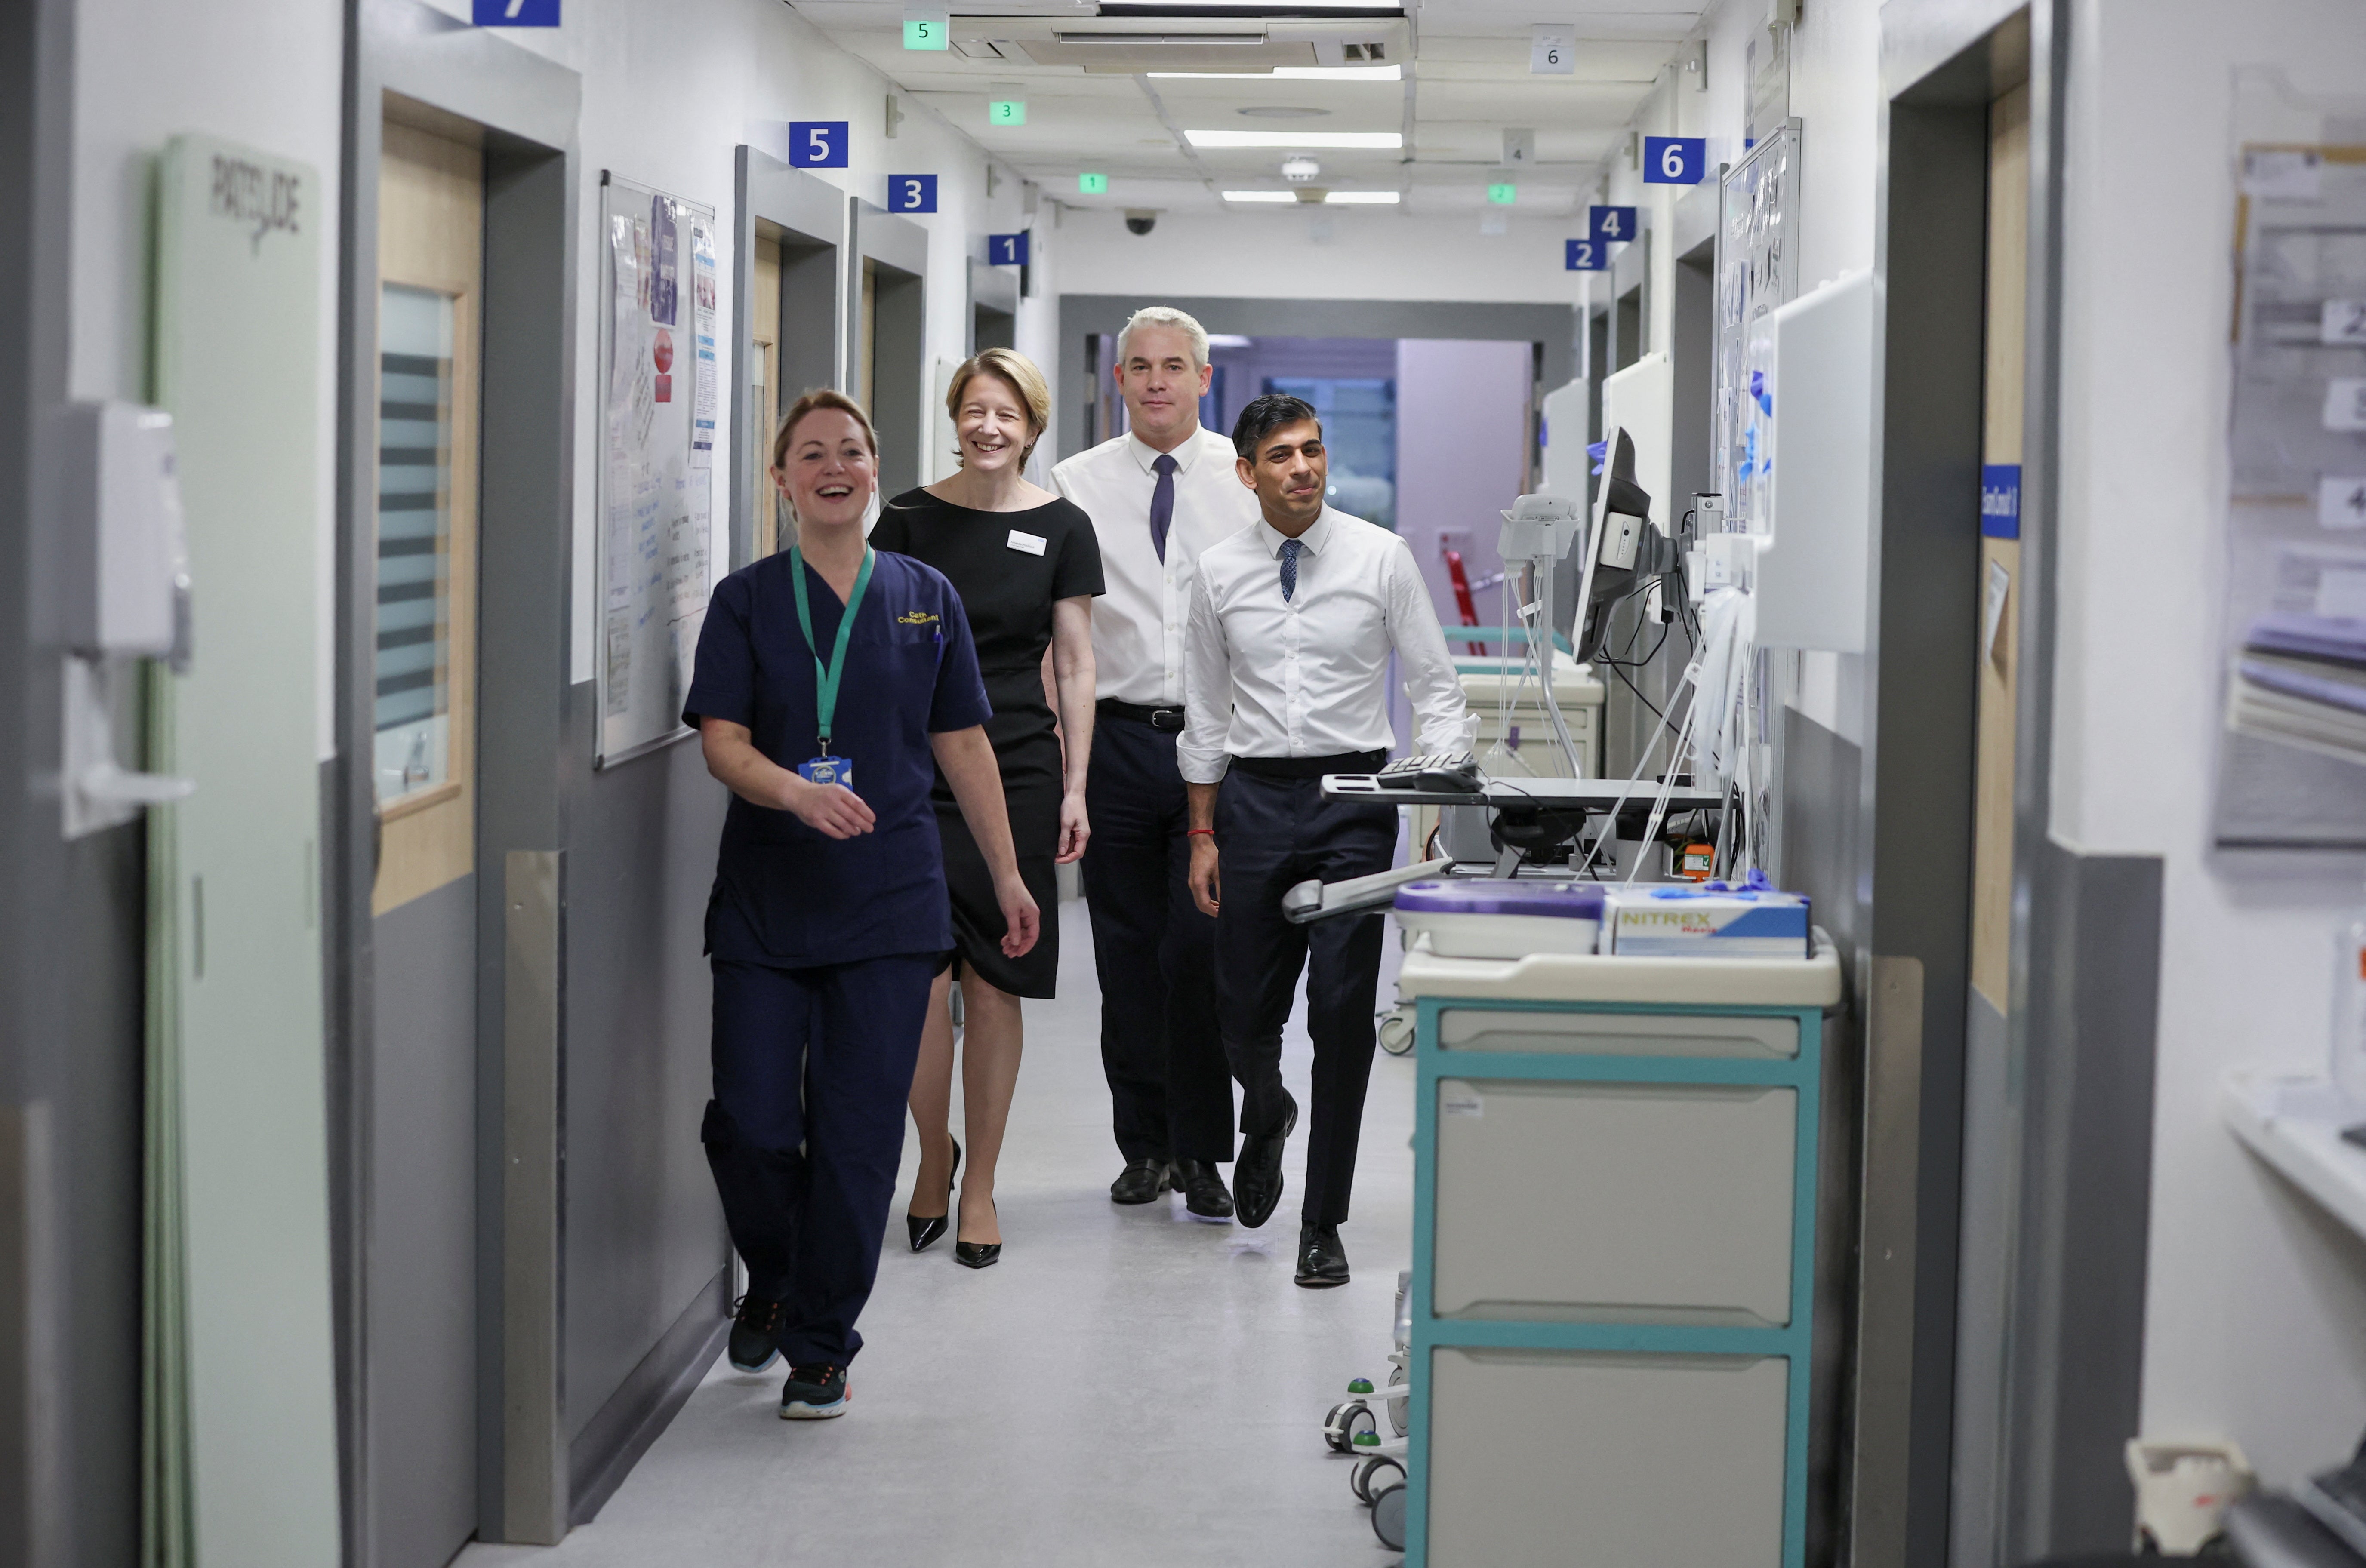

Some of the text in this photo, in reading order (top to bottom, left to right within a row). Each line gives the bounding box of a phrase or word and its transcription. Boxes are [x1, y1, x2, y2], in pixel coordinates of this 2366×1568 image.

[919, 23, 928, 38] 5
[1548, 50, 1558, 64] 6
[1003, 105, 1011, 117] 3
[810, 129, 829, 161] 5
[1662, 144, 1684, 178] 6
[904, 180, 922, 208] 3
[1601, 211, 1621, 237] 4
[1004, 238, 1015, 261] 1
[1575, 243, 1593, 267] 2
[1622, 911, 1710, 925] NITREX
